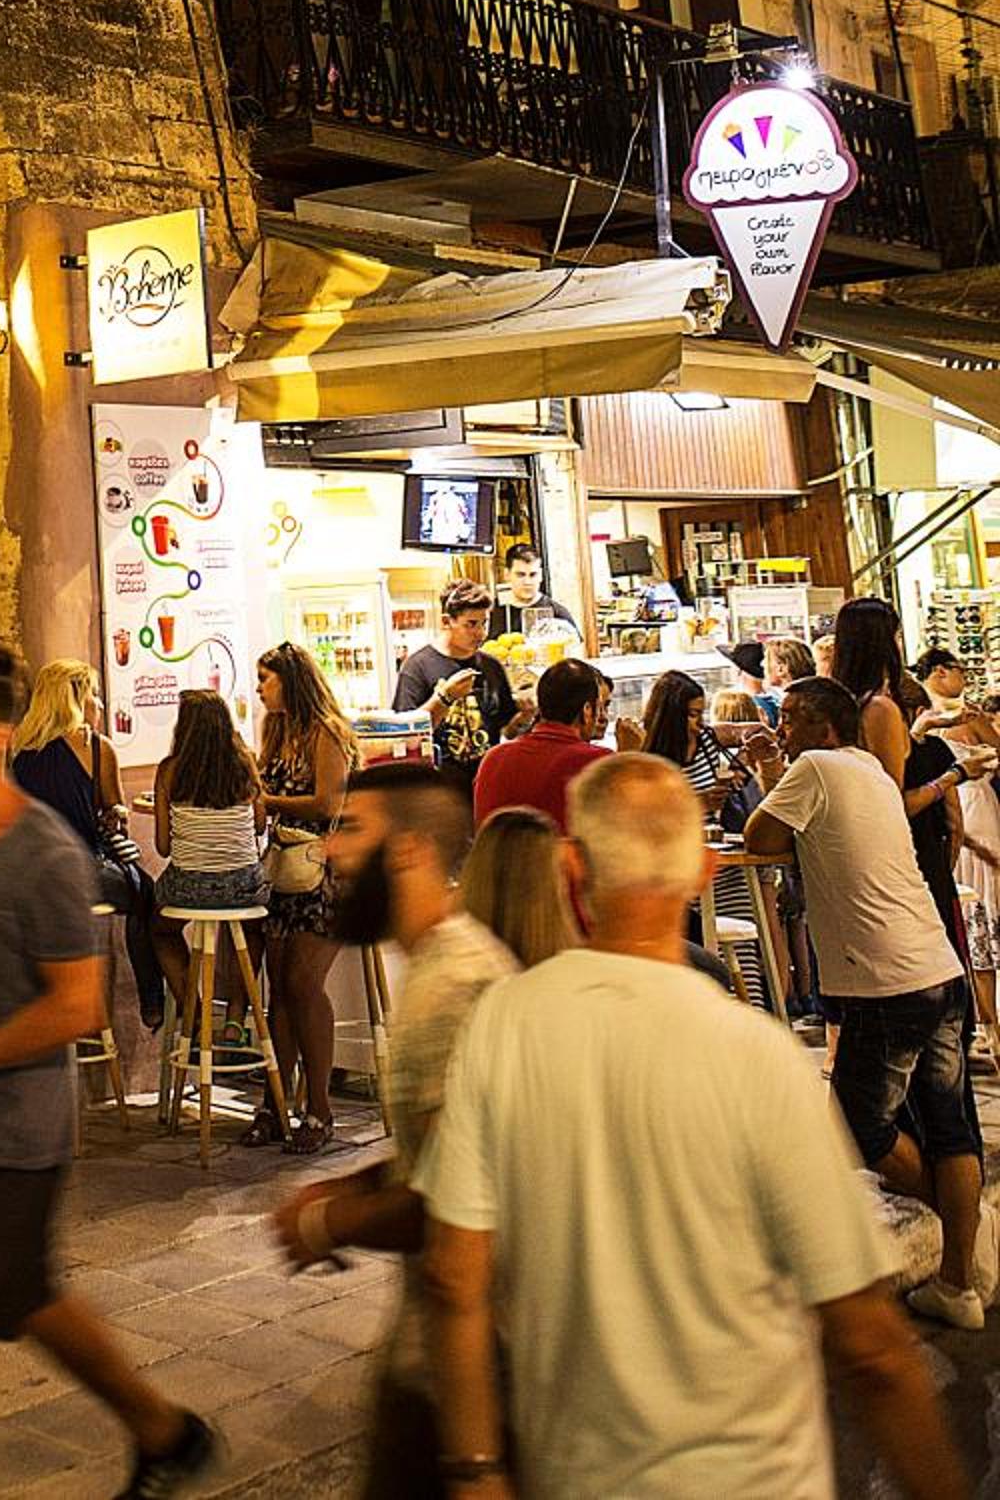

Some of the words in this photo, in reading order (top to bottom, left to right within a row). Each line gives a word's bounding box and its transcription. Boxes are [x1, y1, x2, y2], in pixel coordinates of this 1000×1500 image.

[747, 213, 795, 231] Create
[753, 231, 791, 249] your
[755, 248, 791, 260] own
[750, 261, 796, 276] flavor
